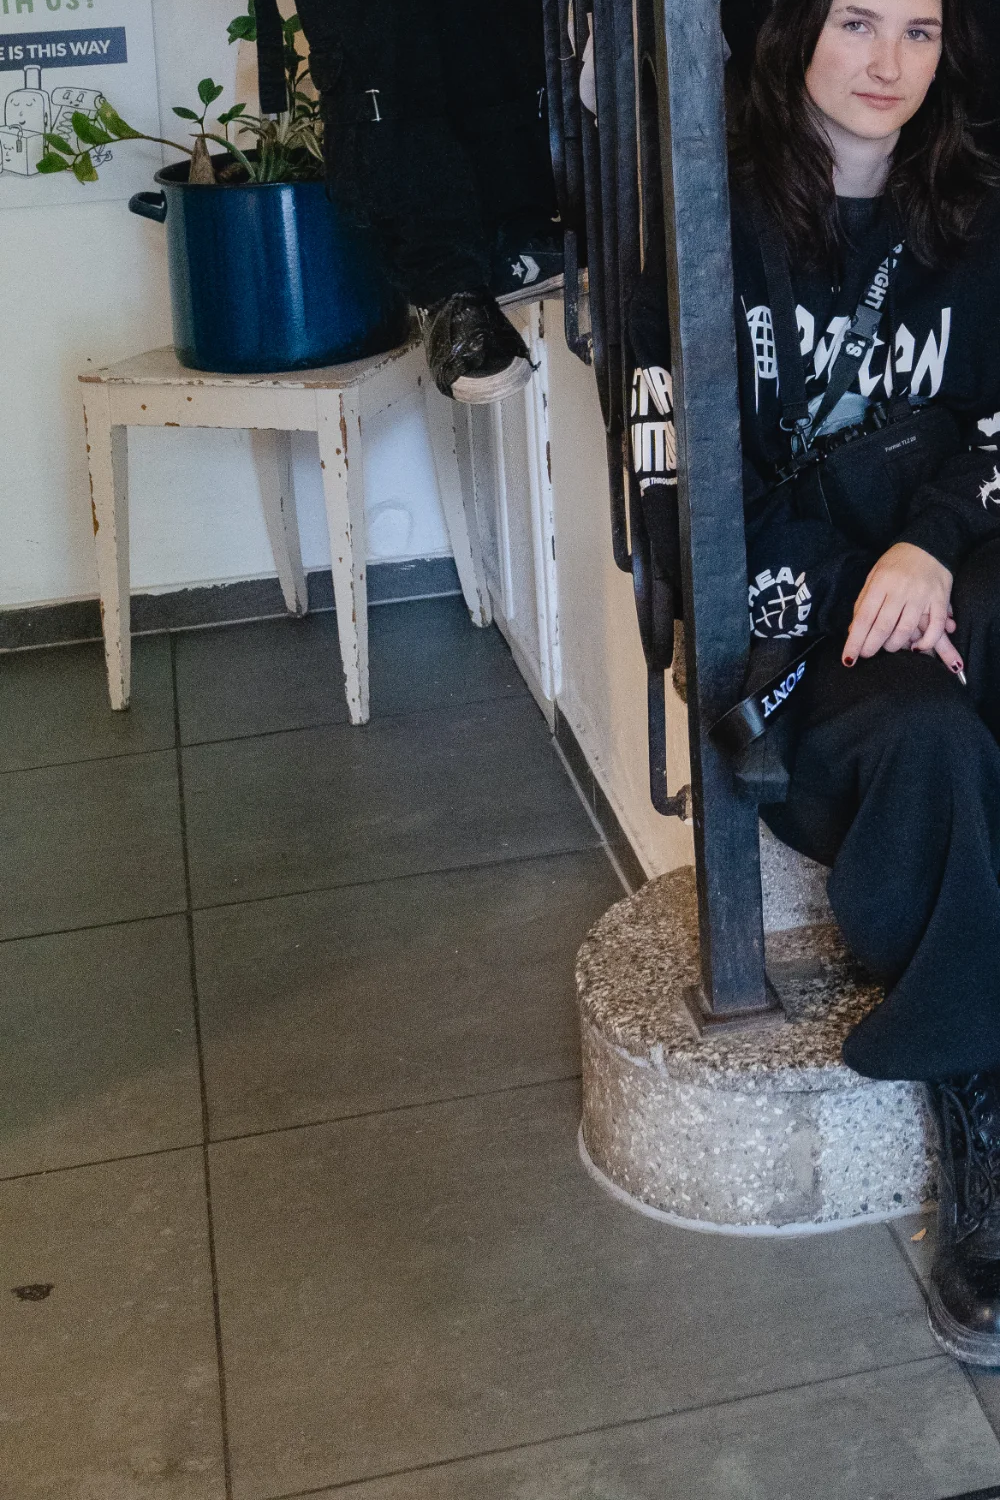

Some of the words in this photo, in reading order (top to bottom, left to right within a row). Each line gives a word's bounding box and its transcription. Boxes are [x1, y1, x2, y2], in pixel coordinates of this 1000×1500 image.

[8, 45, 24, 60] IS
[26, 42, 67, 59] THIS
[68, 39, 111, 57] WAY
[760, 660, 807, 718] SONY
